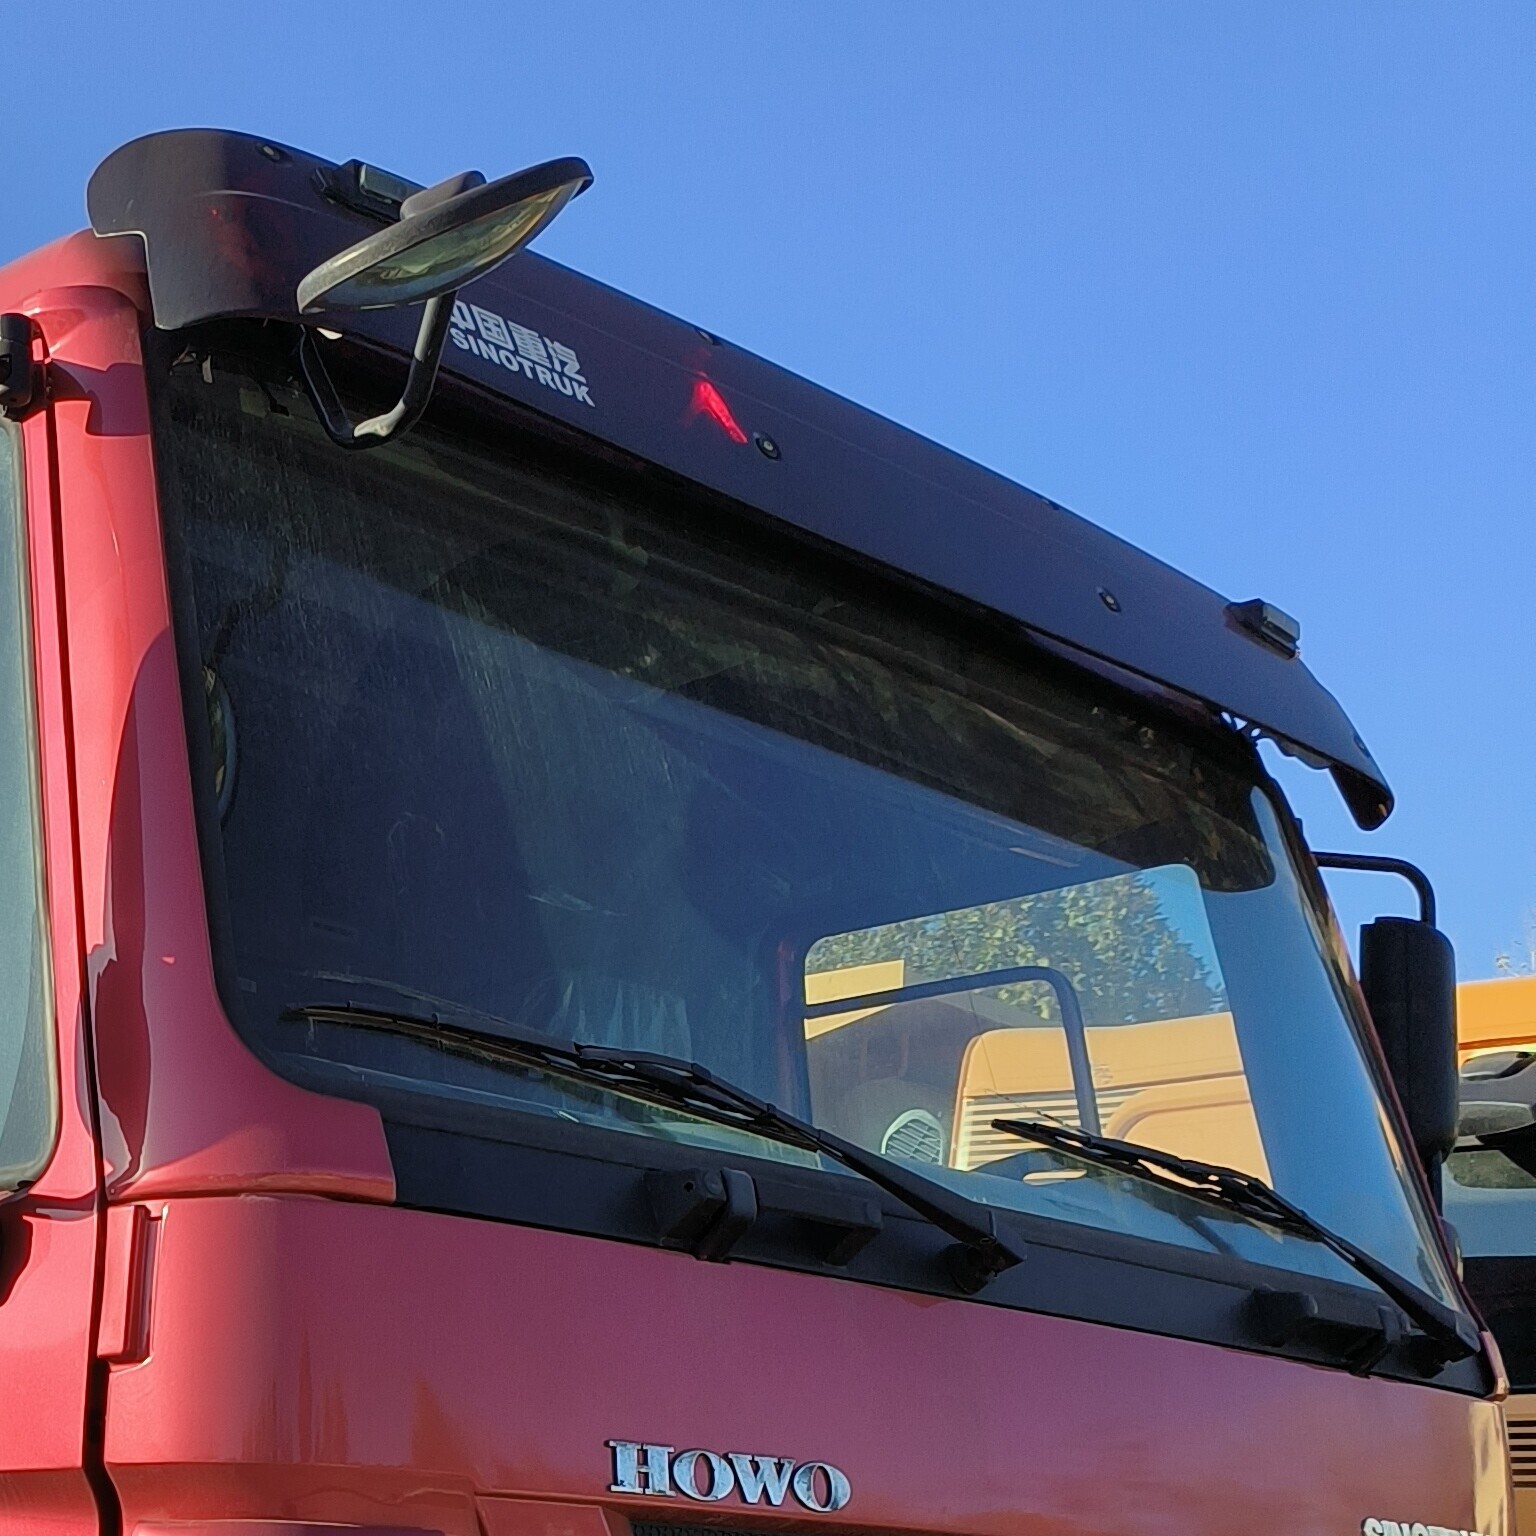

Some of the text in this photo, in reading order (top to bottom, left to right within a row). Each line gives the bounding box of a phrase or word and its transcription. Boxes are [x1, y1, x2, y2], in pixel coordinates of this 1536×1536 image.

[449, 328, 596, 408] SINOTRUK
[450, 300, 587, 385] 中国重汽
[606, 1440, 853, 1513] HOWO
